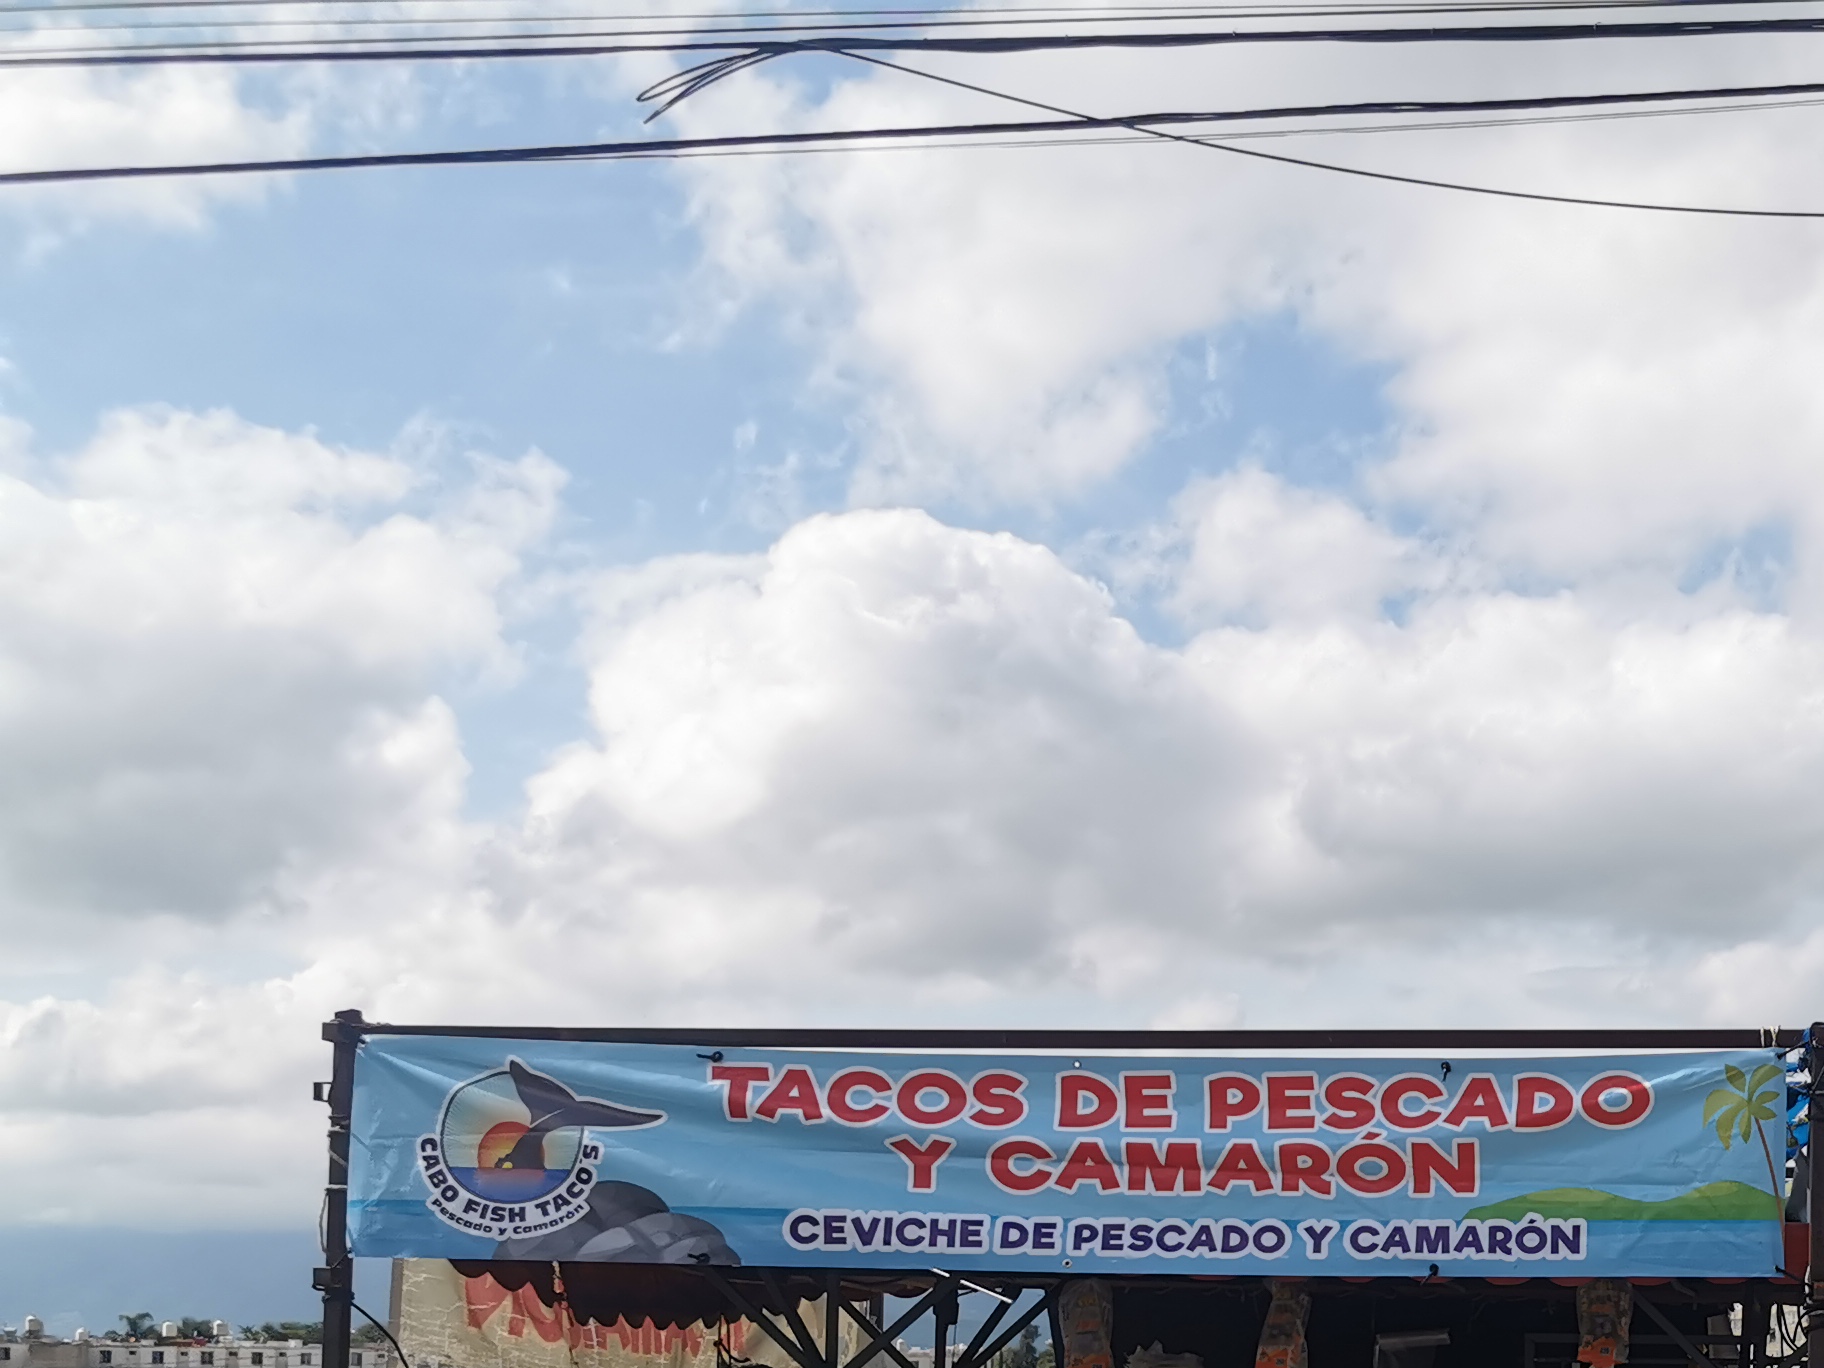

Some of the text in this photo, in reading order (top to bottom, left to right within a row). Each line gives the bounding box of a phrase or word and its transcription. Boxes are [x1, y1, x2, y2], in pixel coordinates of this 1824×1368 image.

[711, 1066, 1651, 1129] TACOS DE PESCADO
[421, 1137, 459, 1202] CABO
[462, 1198, 527, 1223] FISH
[887, 1131, 1477, 1195] Y CAMARÓN
[431, 1198, 584, 1236] Pescado y Camarón
[789, 1214, 1584, 1257] CEVICHE DE PESCADO Y CAMARÓN
